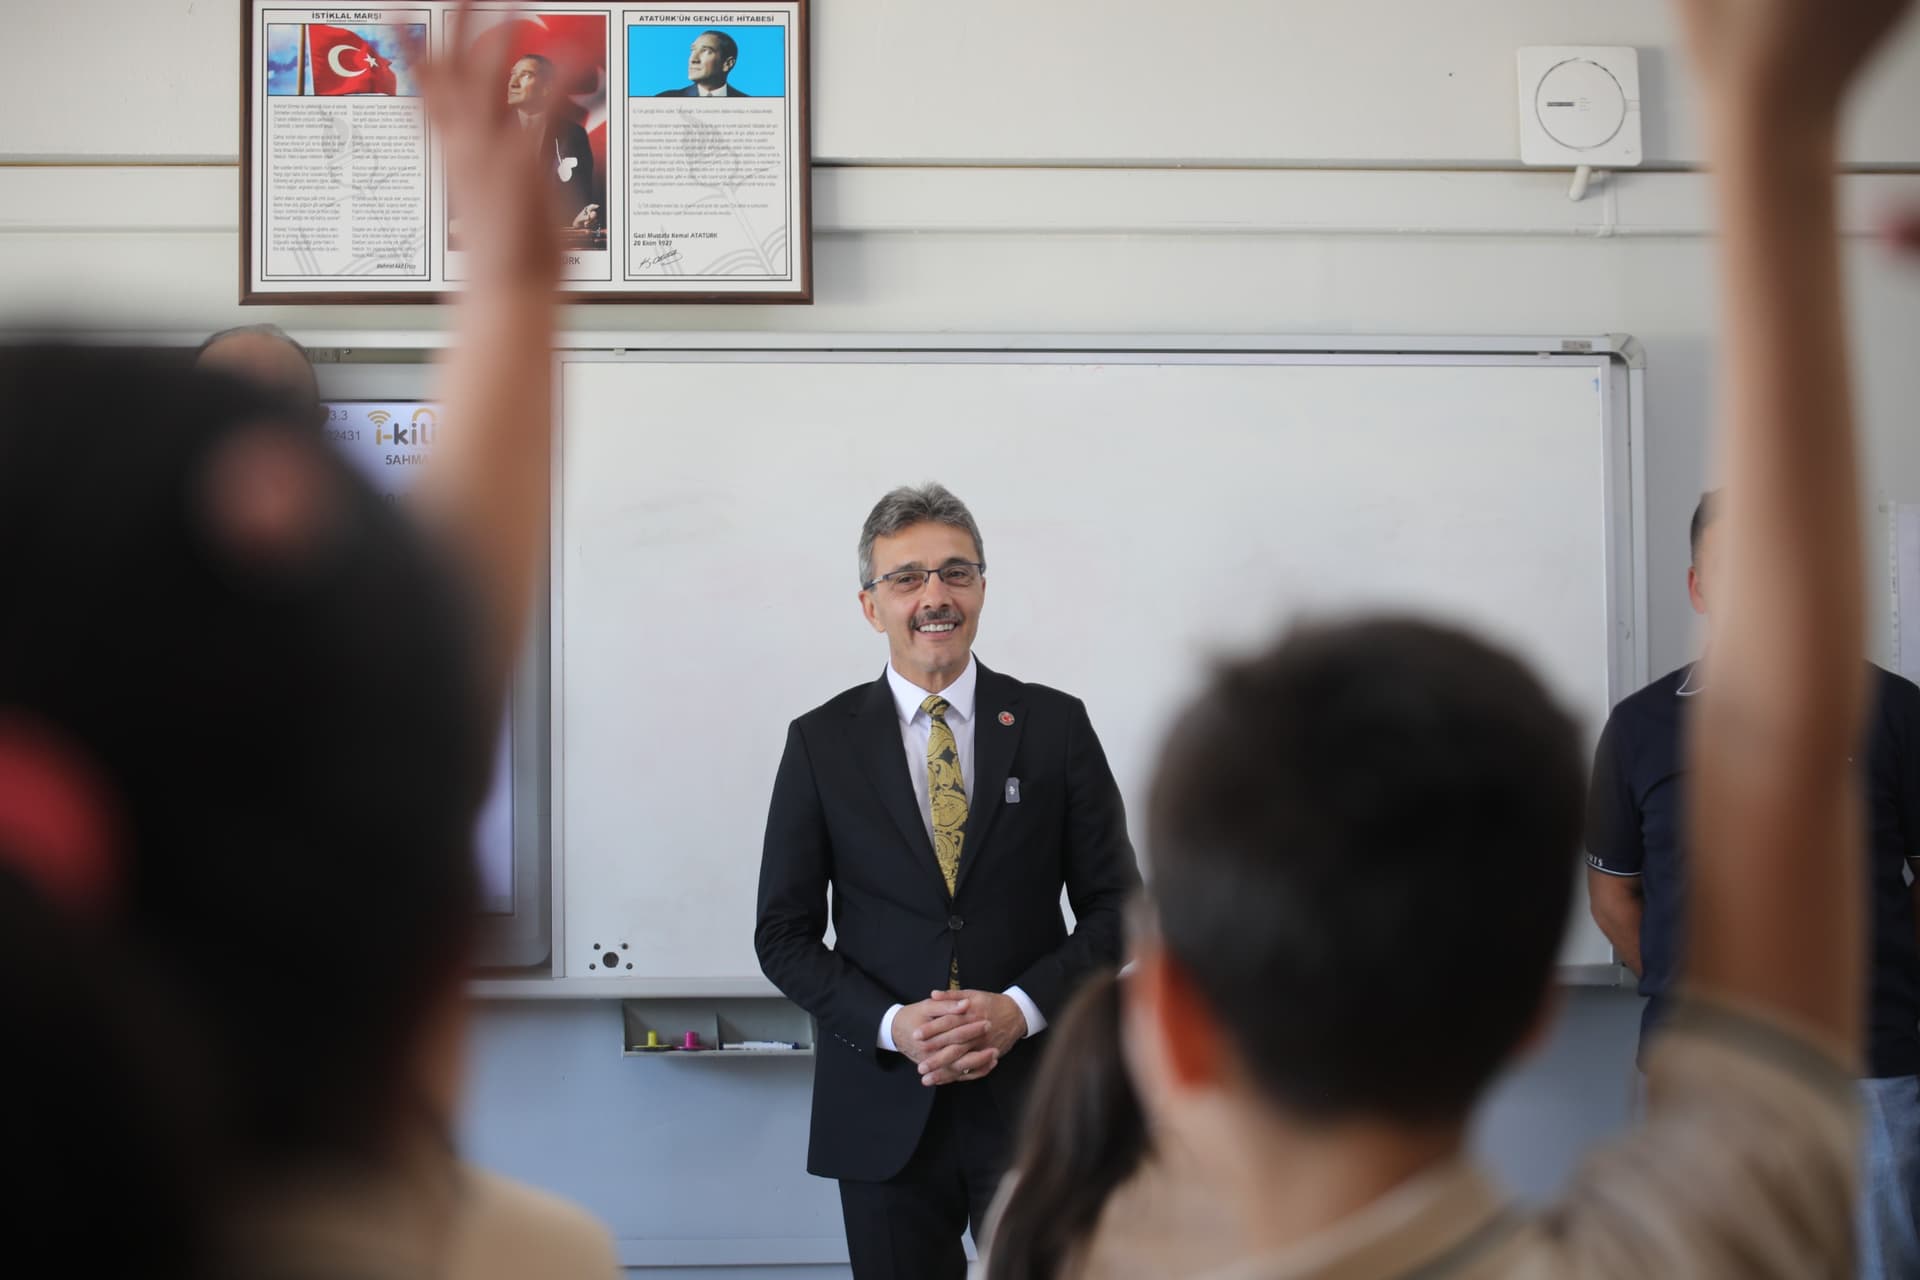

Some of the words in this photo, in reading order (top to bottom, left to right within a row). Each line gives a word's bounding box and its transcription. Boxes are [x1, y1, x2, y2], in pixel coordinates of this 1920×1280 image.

[311, 11, 352, 20] İSTİKLAL
[353, 12, 382, 21] MARŞI
[639, 14, 691, 22] ATATÜRK'ÜN
[692, 14, 735, 24] GENÇLİĞE
[690, 231, 718, 239] ATATÜRK
